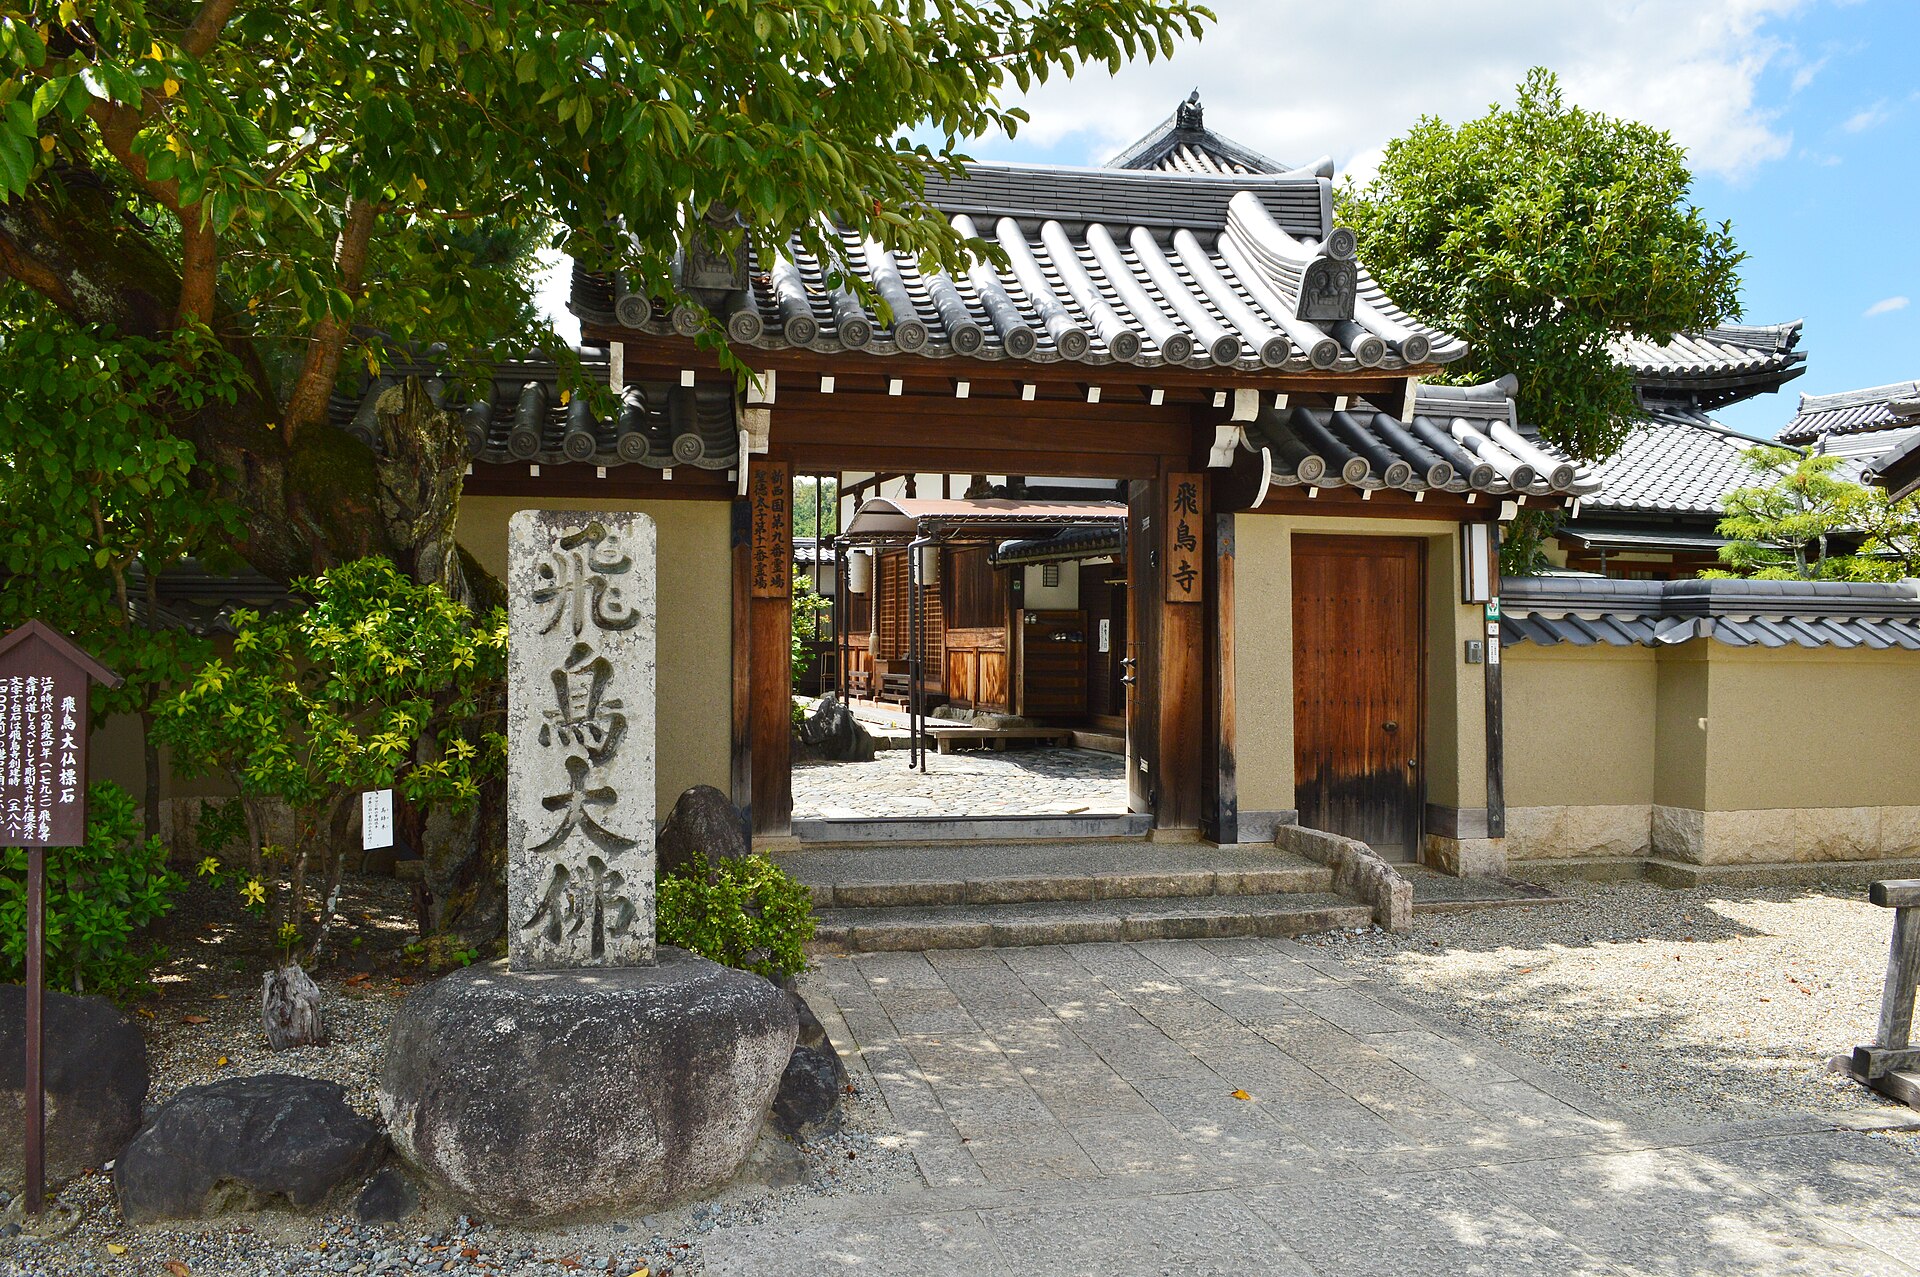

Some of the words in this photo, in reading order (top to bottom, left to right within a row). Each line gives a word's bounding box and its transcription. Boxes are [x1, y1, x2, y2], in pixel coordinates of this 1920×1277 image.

[1172, 481, 1199, 594] 飛鳥寺
[59, 695, 79, 804] 飛鳥大仏標石
[522, 520, 641, 960] 飛鳥大佛
